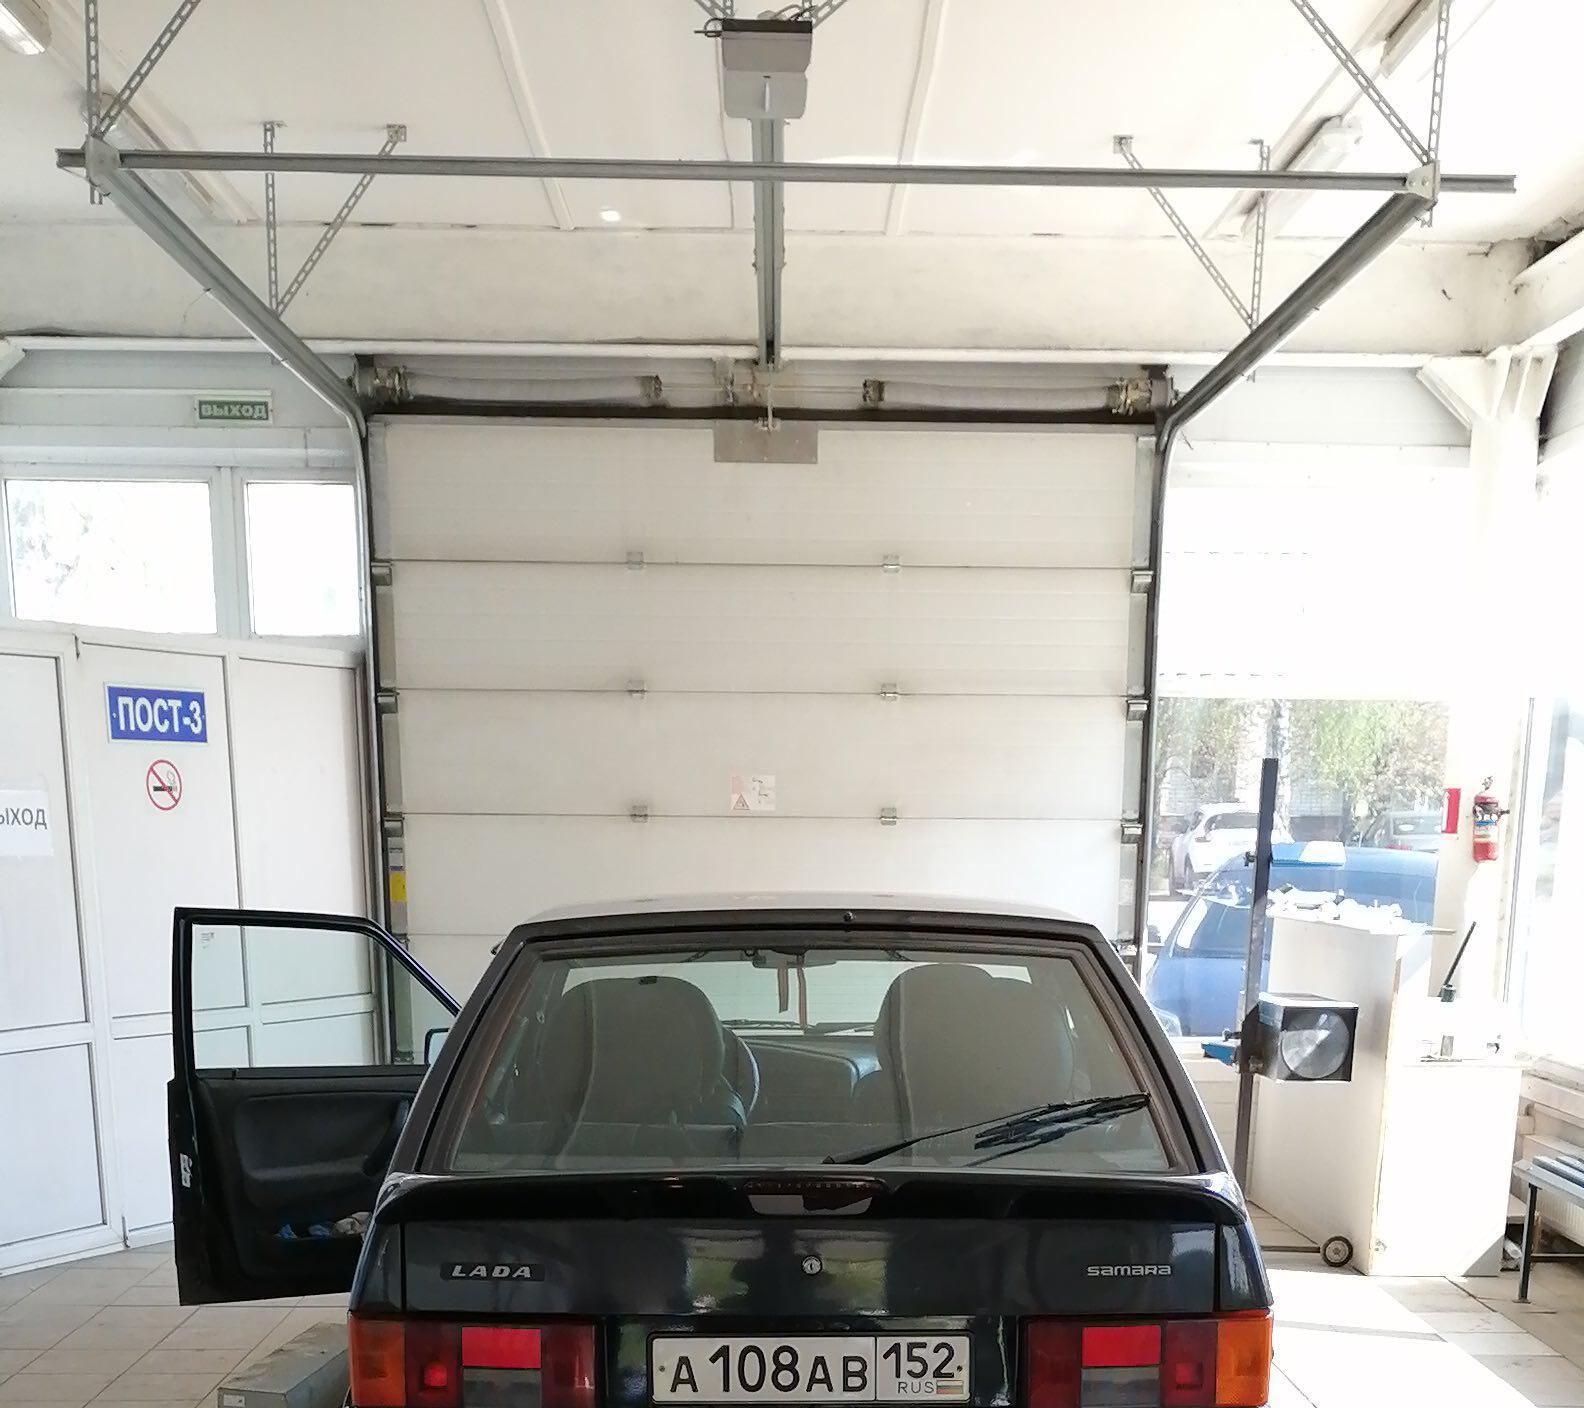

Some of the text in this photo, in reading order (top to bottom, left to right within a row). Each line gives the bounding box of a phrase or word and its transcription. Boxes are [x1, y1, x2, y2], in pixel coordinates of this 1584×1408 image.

[201, 404, 267, 419] ВЫХОД
[117, 696, 202, 734] ПОСТ-3
[452, 1265, 531, 1278] LADA
[669, 1344, 869, 1393] А108АВ
[882, 1341, 955, 1379] 152
[897, 1381, 935, 1394] RUS
